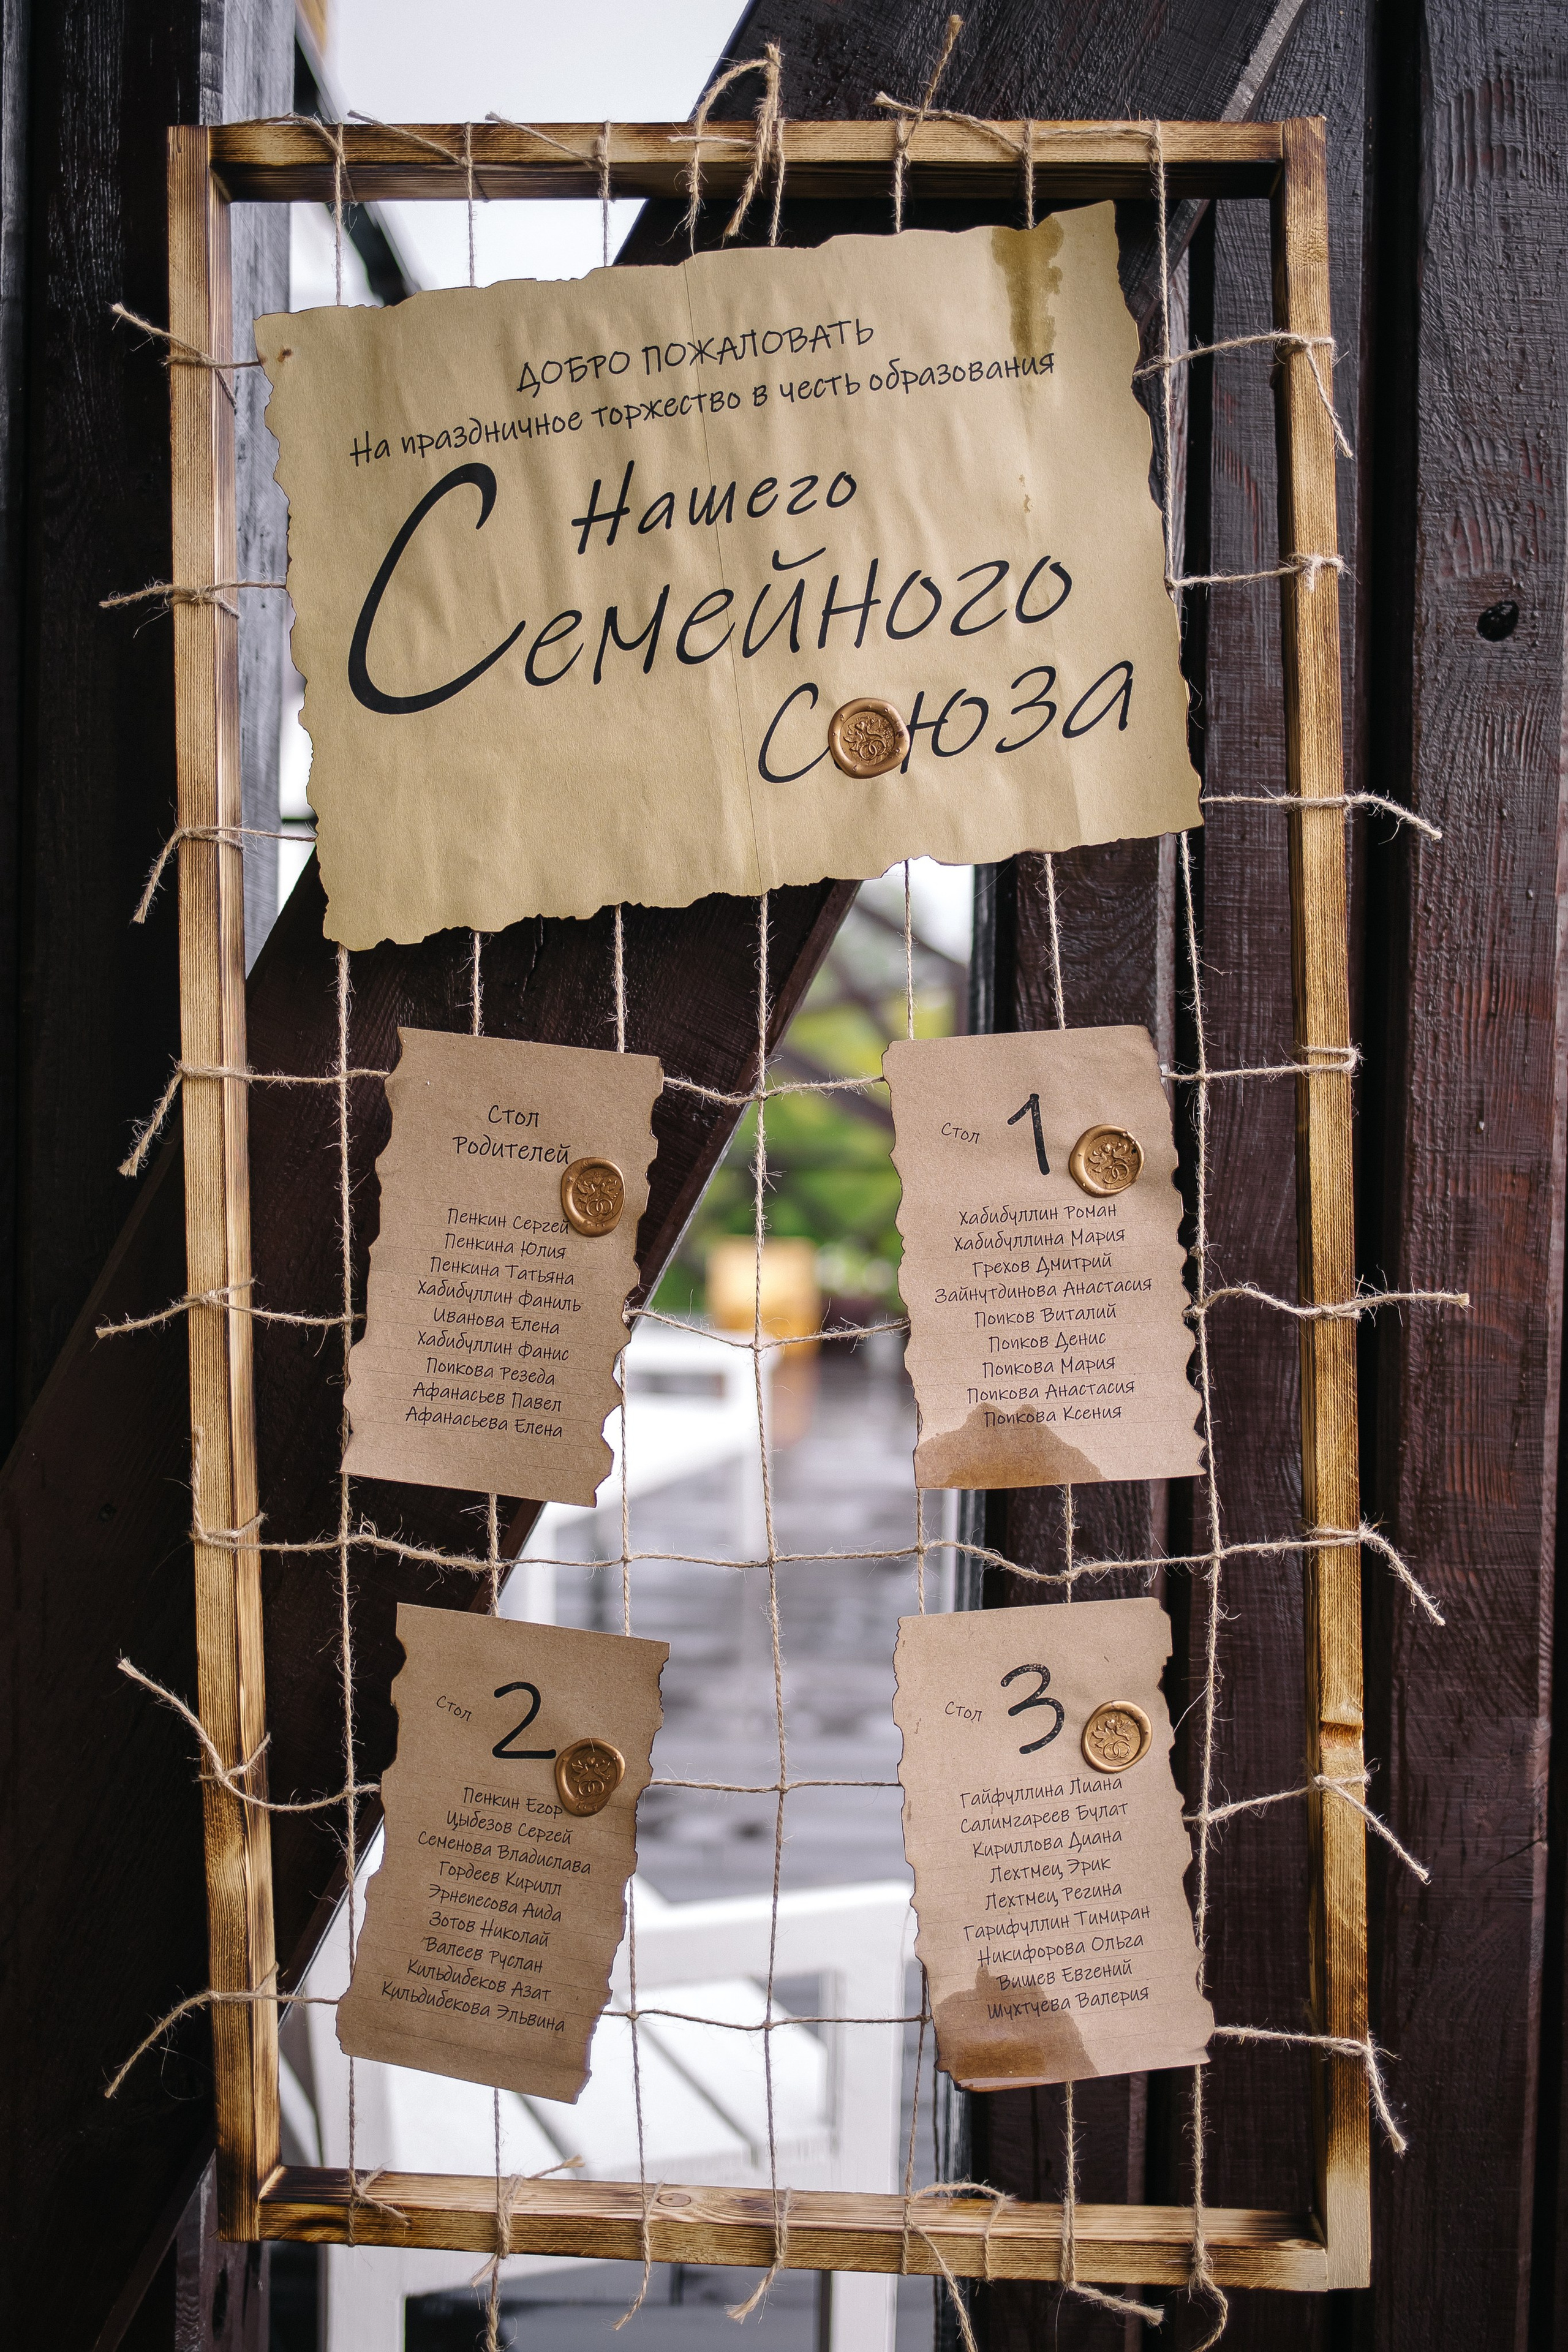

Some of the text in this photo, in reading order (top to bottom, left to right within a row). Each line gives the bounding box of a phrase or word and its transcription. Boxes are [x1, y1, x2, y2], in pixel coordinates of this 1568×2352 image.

[516, 318, 874, 399] ДОБРО ПОЖАЛОВАТЬ
[349, 352, 1055, 467] На праздничное торжество в честь образования
[571, 459, 858, 555] Нашего
[348, 462, 1072, 715] Семейного
[758, 660, 1134, 783] Сюза
[488, 1104, 540, 1128] Стол
[452, 1134, 571, 1165] Родителей
[941, 1093, 1050, 1176] Стол 1
[448, 1207, 570, 1235] Пенкин Сергей
[959, 1204, 1117, 1226] Хабибуллин Роман
[445, 1232, 567, 1259] Пенкина Юлия
[954, 1228, 1125, 1252] Хабибуллина Мария
[431, 1256, 574, 1285] Пенкина Татьяна
[972, 1252, 1112, 1278] Грехов Дмитрий
[417, 1279, 581, 1312] Хабибуллин Фаниль
[935, 1278, 1152, 1304] Зайнутдинова Анастасия
[434, 1307, 559, 1335] Иванова Елена
[974, 1303, 1117, 1329] Попков Виталий
[417, 1330, 569, 1361] Хабибуллин Фанис
[988, 1332, 1106, 1353] Попков Денис
[426, 1357, 555, 1385] Попкова Резеда
[982, 1356, 1115, 1379] Попкова Мария
[413, 1381, 562, 1412] Афанасьев Павел
[967, 1381, 1135, 1404] Попкова Анастасия
[405, 1406, 562, 1438] Афанасьева Елена
[984, 1405, 1122, 1428] Попкова Ксения
[436, 1681, 557, 1760] Стол 2
[944, 1663, 1065, 1755] Стол 3
[463, 1786, 564, 1820] Пенкин Егор
[960, 1777, 1123, 1809] Гайфуллина Лиана
[447, 1810, 573, 1845] Цыбезов Сергей
[960, 1803, 1128, 1833] Салимгареев Булат
[418, 1831, 590, 1875] Семенова Владислава
[973, 1830, 1122, 1860] Кириллова Диана
[440, 1861, 562, 1896] Гордеев Кирилл
[990, 1858, 1111, 1883] Лехтмец Эрик
[429, 1883, 562, 1922] Эрнепесова Аида
[985, 1883, 1122, 1910] Лехтмец Регина
[429, 1911, 551, 1947] Зотов Николай
[963, 1905, 1150, 1942] Гарифуллин Тимиран
[425, 1937, 543, 1973] Валеев Руслан
[977, 1935, 1144, 1968] Никифорова Ольга
[407, 1959, 552, 2002] Кильдибеков Азат
[995, 1959, 1133, 1991] Вишев Евгений
[382, 1981, 565, 2032] Кильдибекова Эльвина
[987, 1986, 1149, 2021] Шухтуева Валерия
